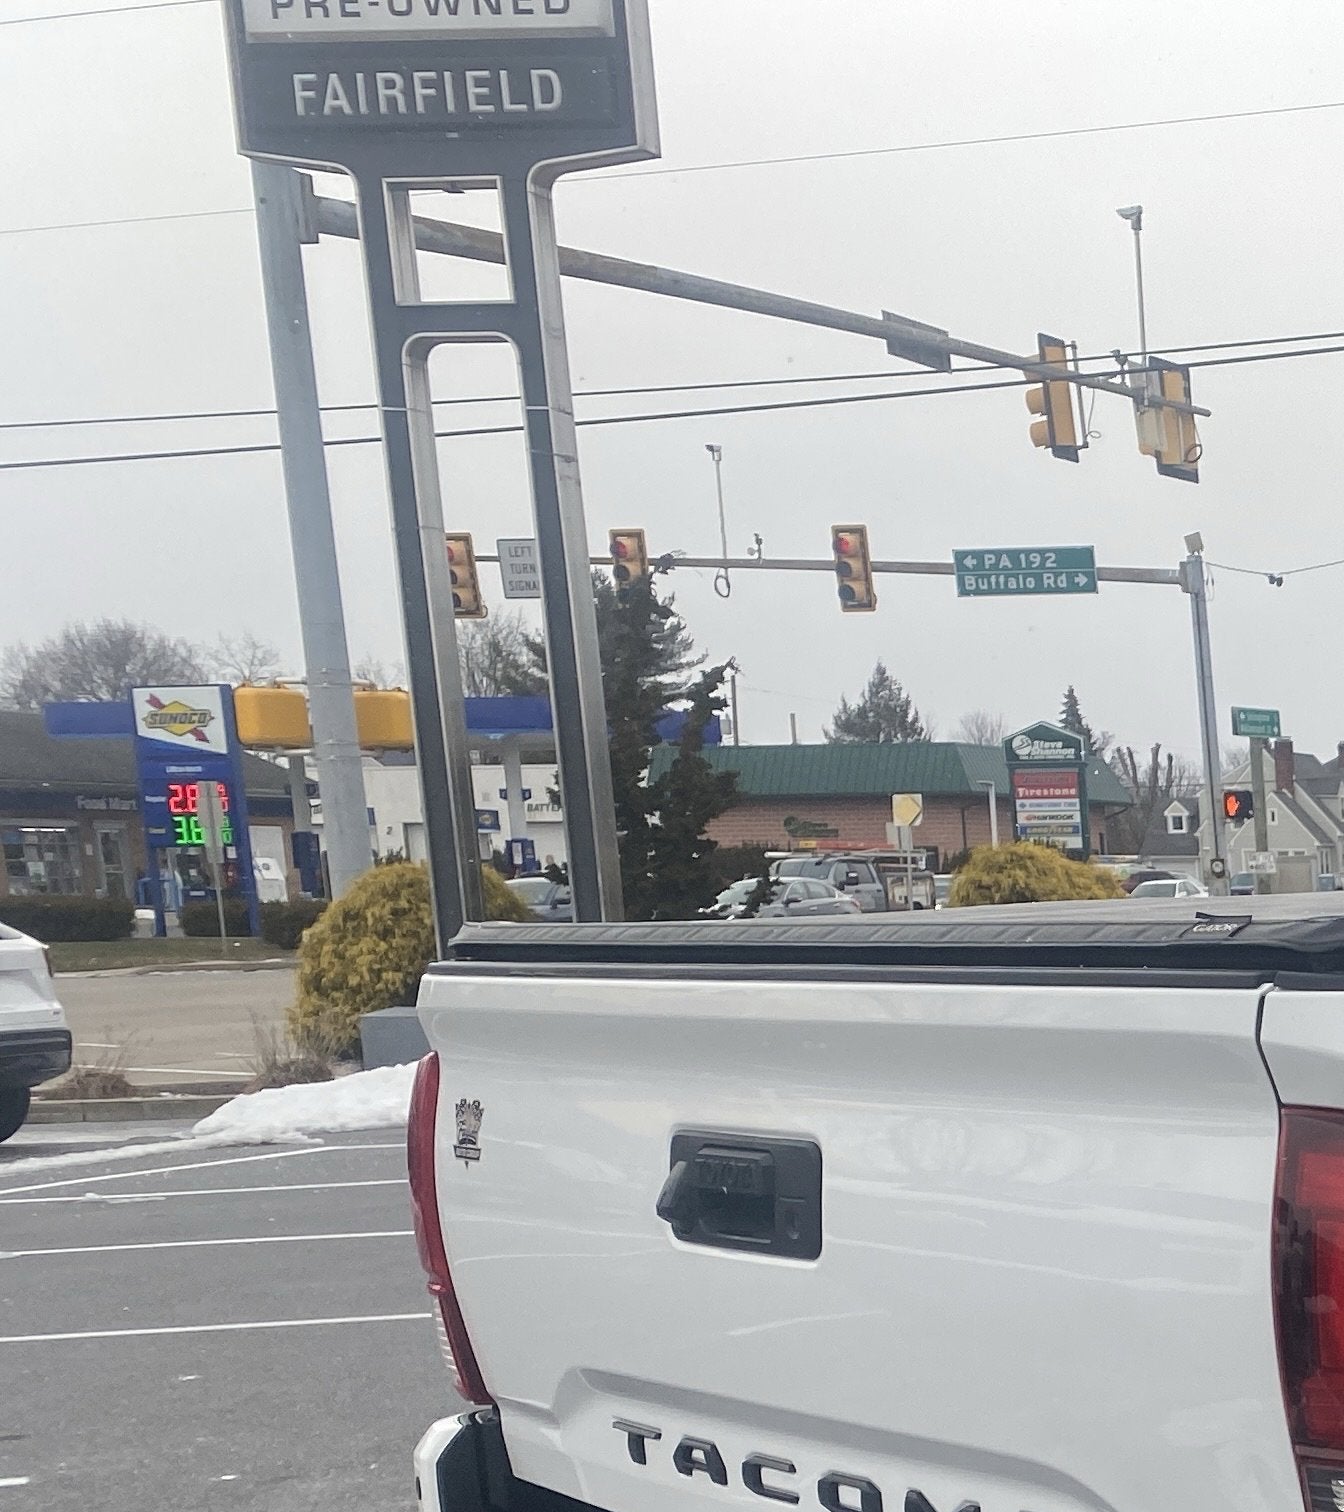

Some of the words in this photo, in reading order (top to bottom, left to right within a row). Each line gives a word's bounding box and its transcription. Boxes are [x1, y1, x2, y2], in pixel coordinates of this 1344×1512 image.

[292, 69, 564, 117] FAIRFIELD
[508, 546, 531, 557] LEFT
[984, 554, 1012, 569] PA
[1019, 552, 1057, 568] 192
[510, 563, 537, 575] TURN
[508, 580, 540, 591] SIGNA
[964, 575, 1036, 590] Buffalo
[1043, 573, 1067, 589] Rd
[149, 712, 208, 725] SUNOCO
[1017, 787, 1076, 797] Firestone
